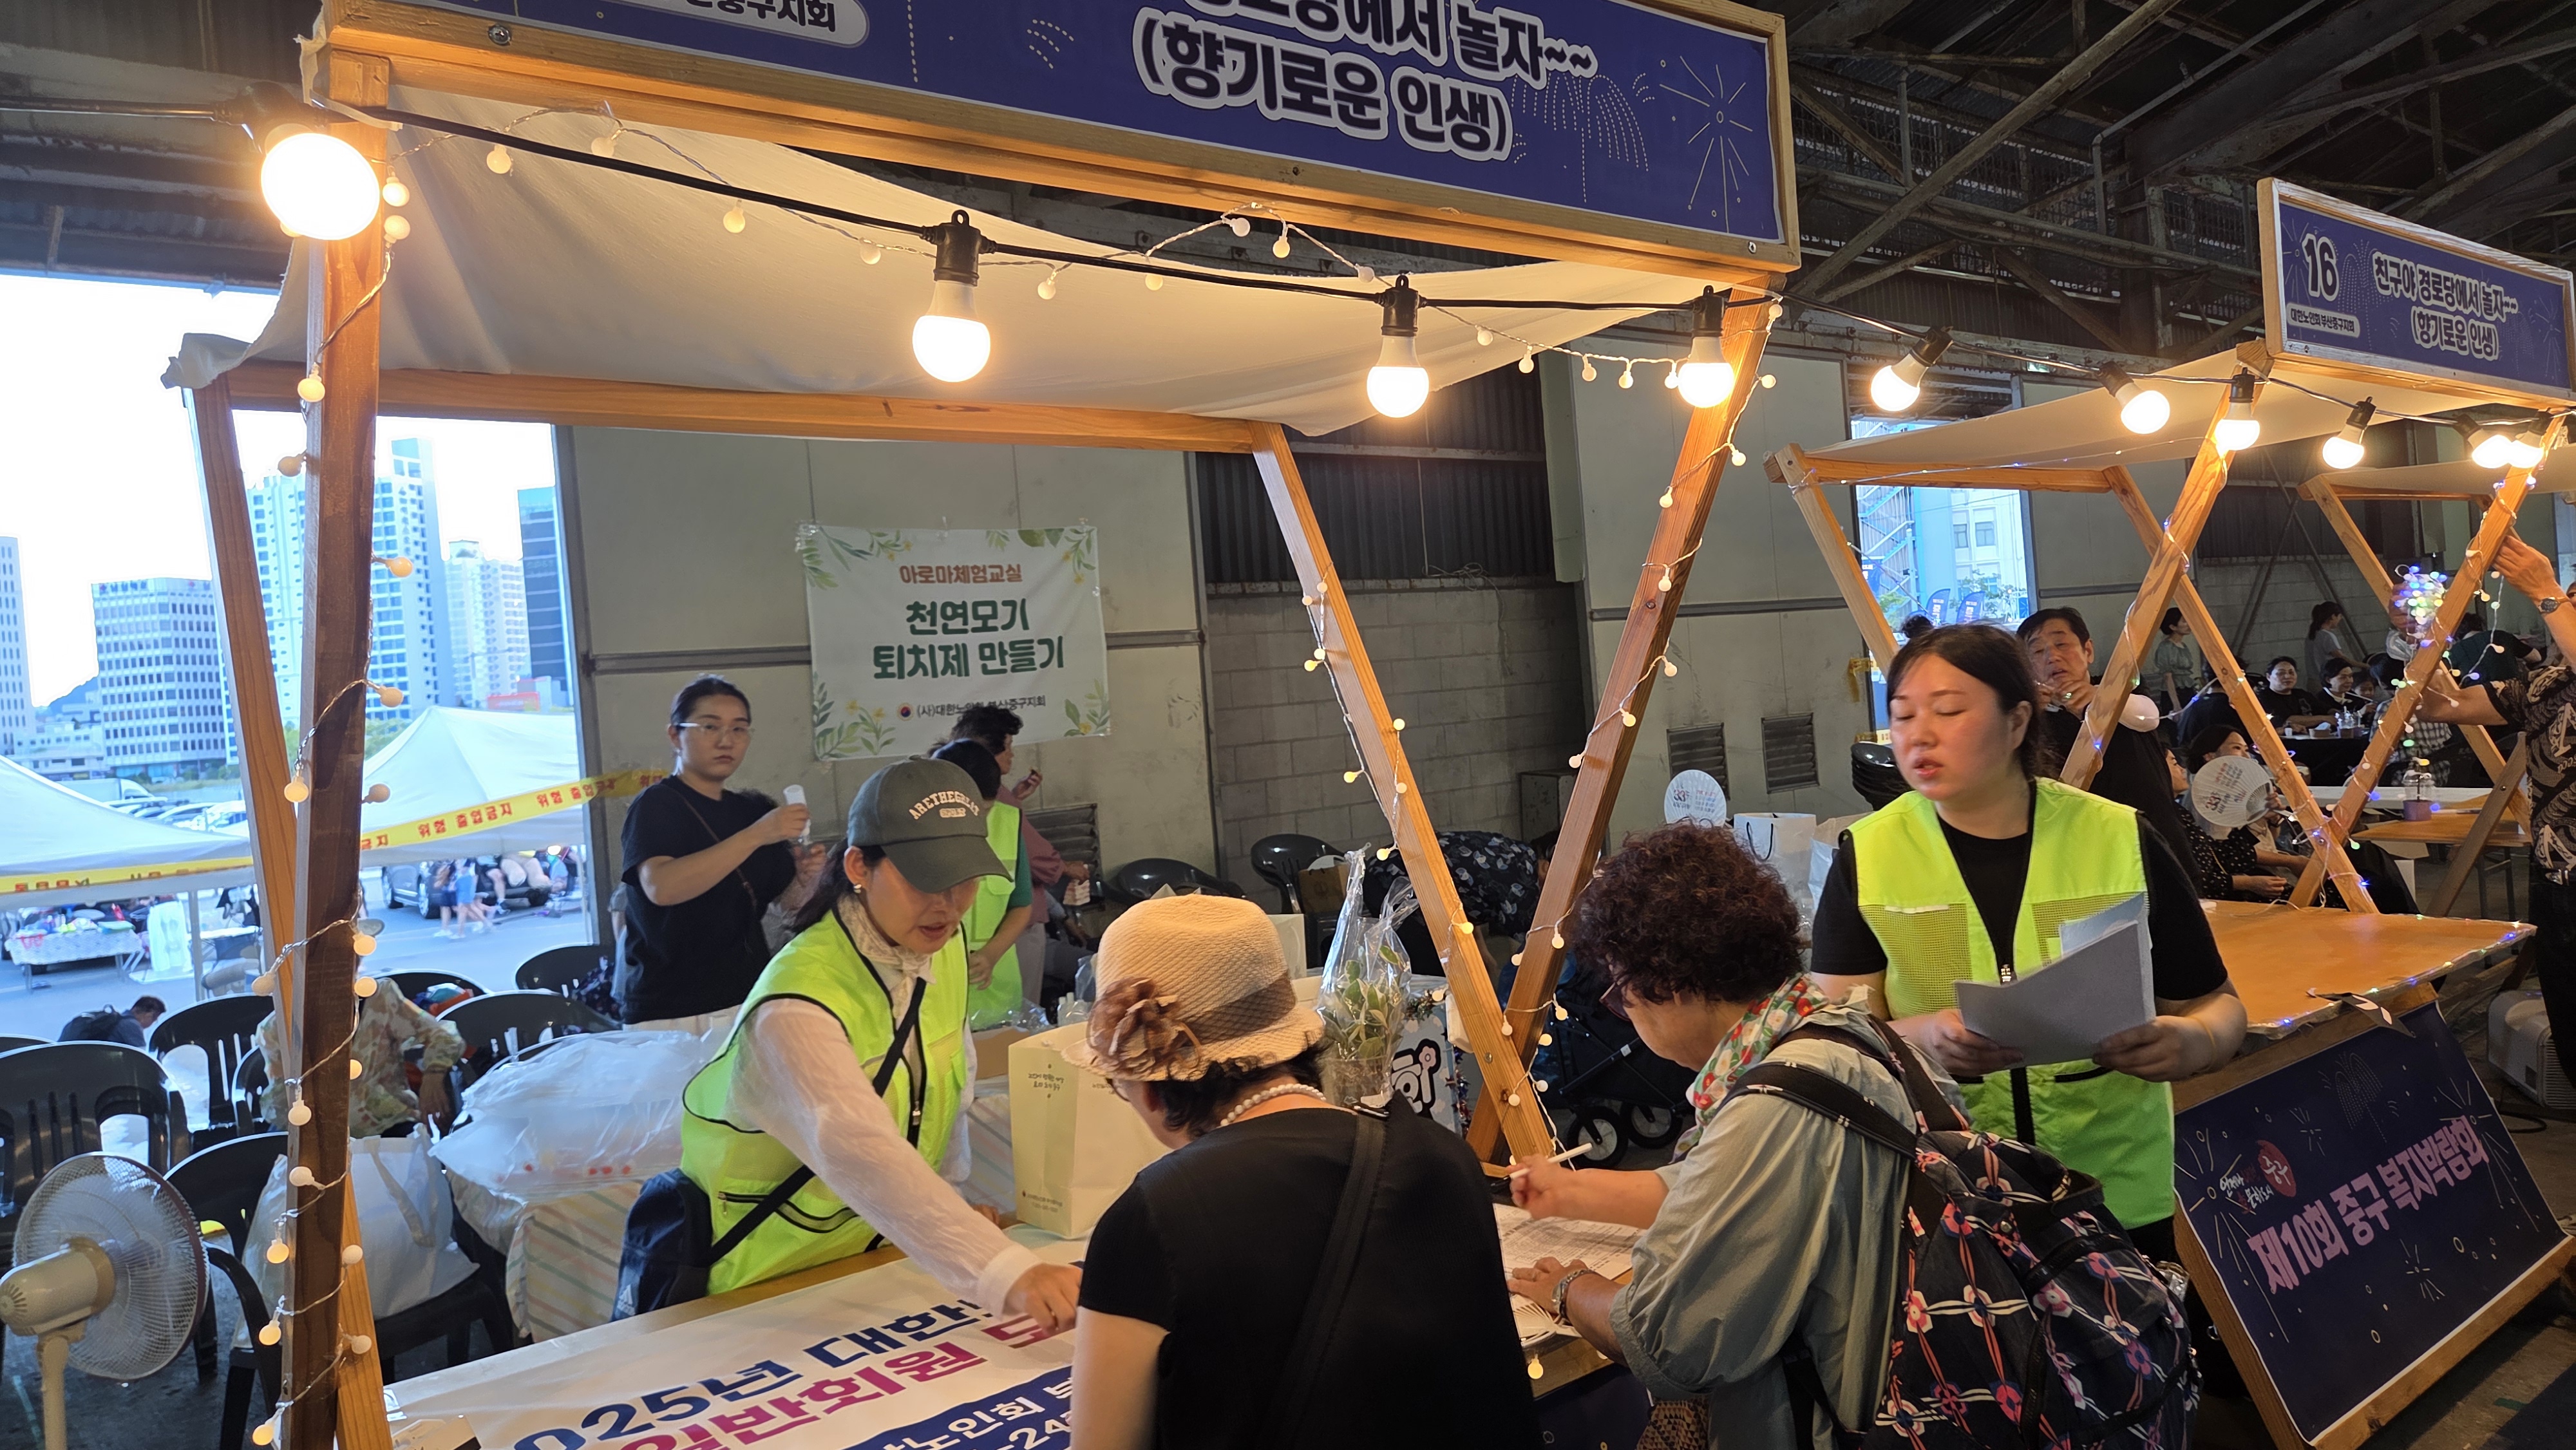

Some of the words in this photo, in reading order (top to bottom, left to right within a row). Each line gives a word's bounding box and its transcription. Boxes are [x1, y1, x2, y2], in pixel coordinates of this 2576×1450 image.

[1141, 17, 1382, 131] (향기로운
[1396, 75, 1507, 153] 인생)
[2304, 238, 2338, 298] 16
[2374, 256, 2416, 297] 친구야
[2418, 268, 2479, 313] 경로당에서
[2412, 310, 2468, 352] (향기로운
[2470, 323, 2497, 357] 인생)
[900, 563, 1024, 584] 아로마체험교실
[905, 598, 1030, 636] 천연모기
[873, 643, 971, 679] 퇴치제
[978, 636, 1064, 676] 만들기
[455, 802, 513, 829] 출입금지
[2262, 1155, 2291, 1186] 중구
[2246, 1200, 2349, 1295] 제10회
[2329, 1173, 2391, 1247] 중구
[2376, 1115, 2490, 1210] 복지박람회
[882, 1396, 1046, 1450] 노인회
